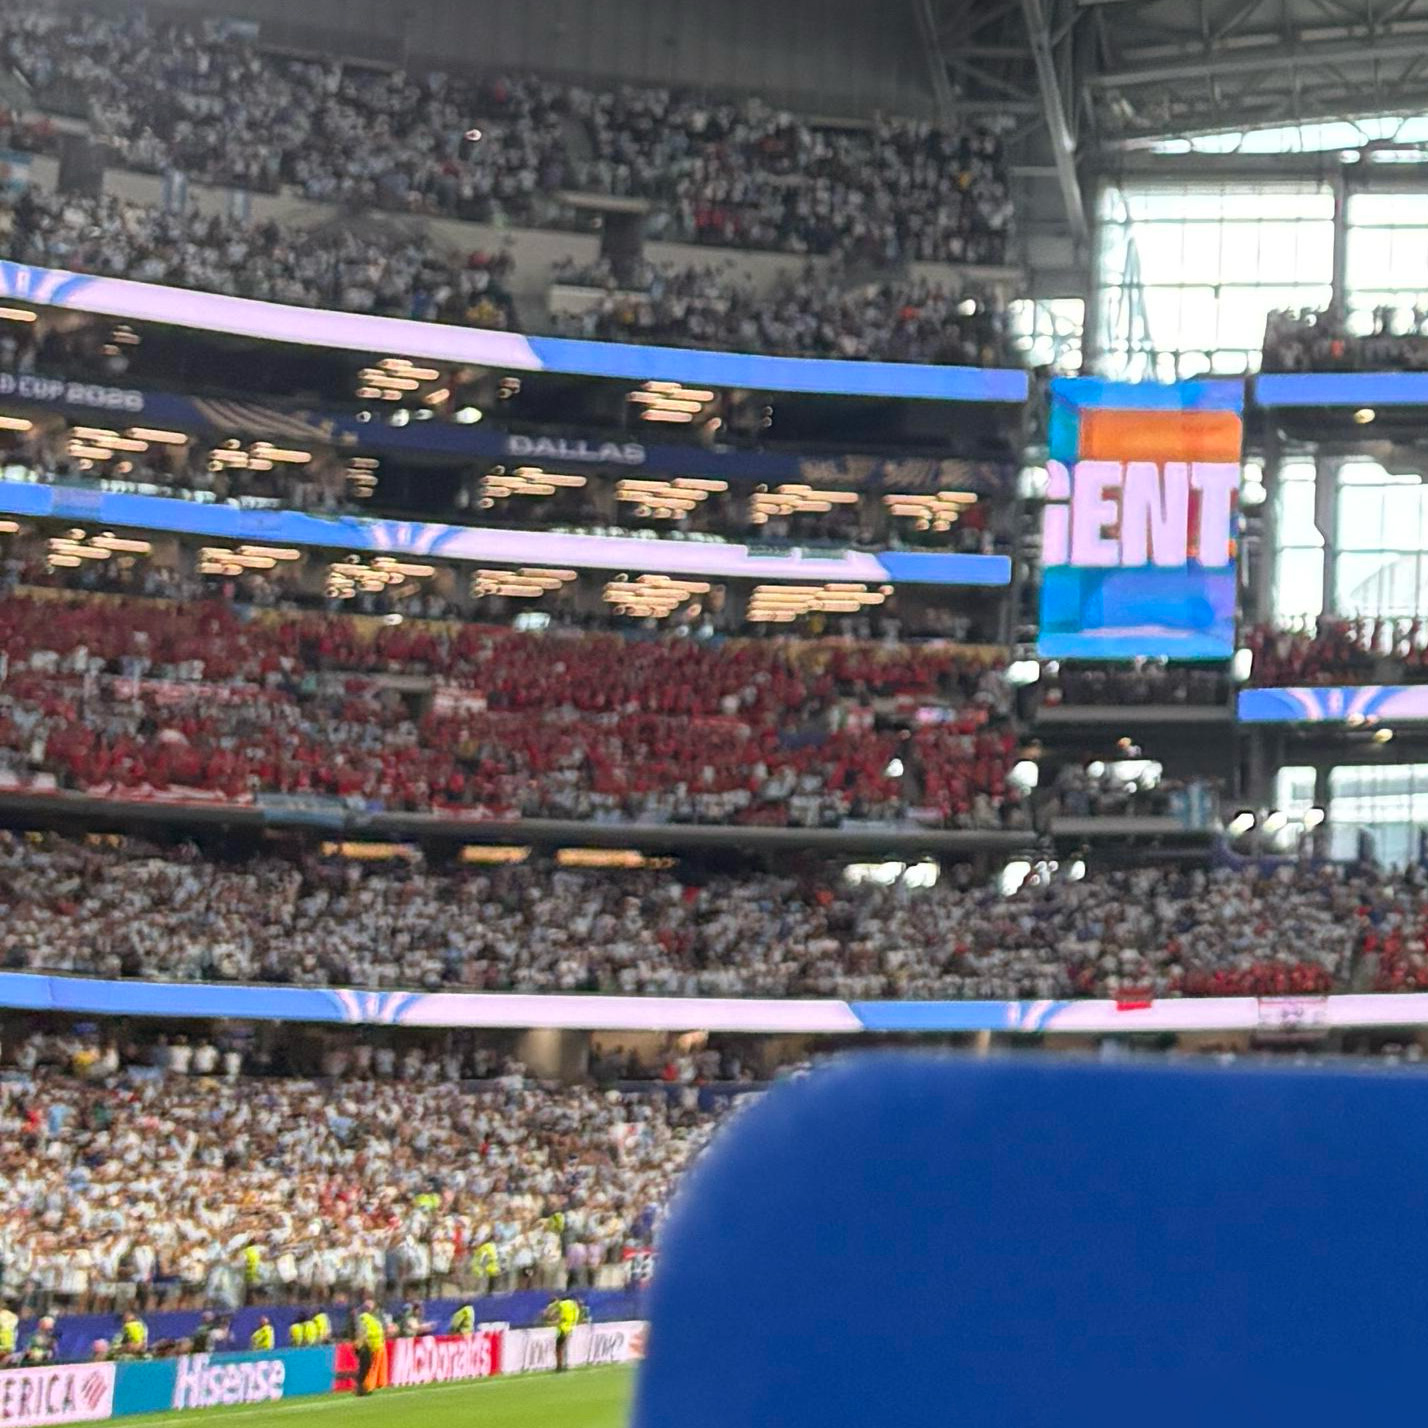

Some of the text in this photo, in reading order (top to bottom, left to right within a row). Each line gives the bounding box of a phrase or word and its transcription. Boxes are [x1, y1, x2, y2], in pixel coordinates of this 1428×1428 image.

[508, 434, 646, 465] DALLAS
[0, 1374, 77, 1419] ERICA
[172, 1353, 285, 1410] Hisense
